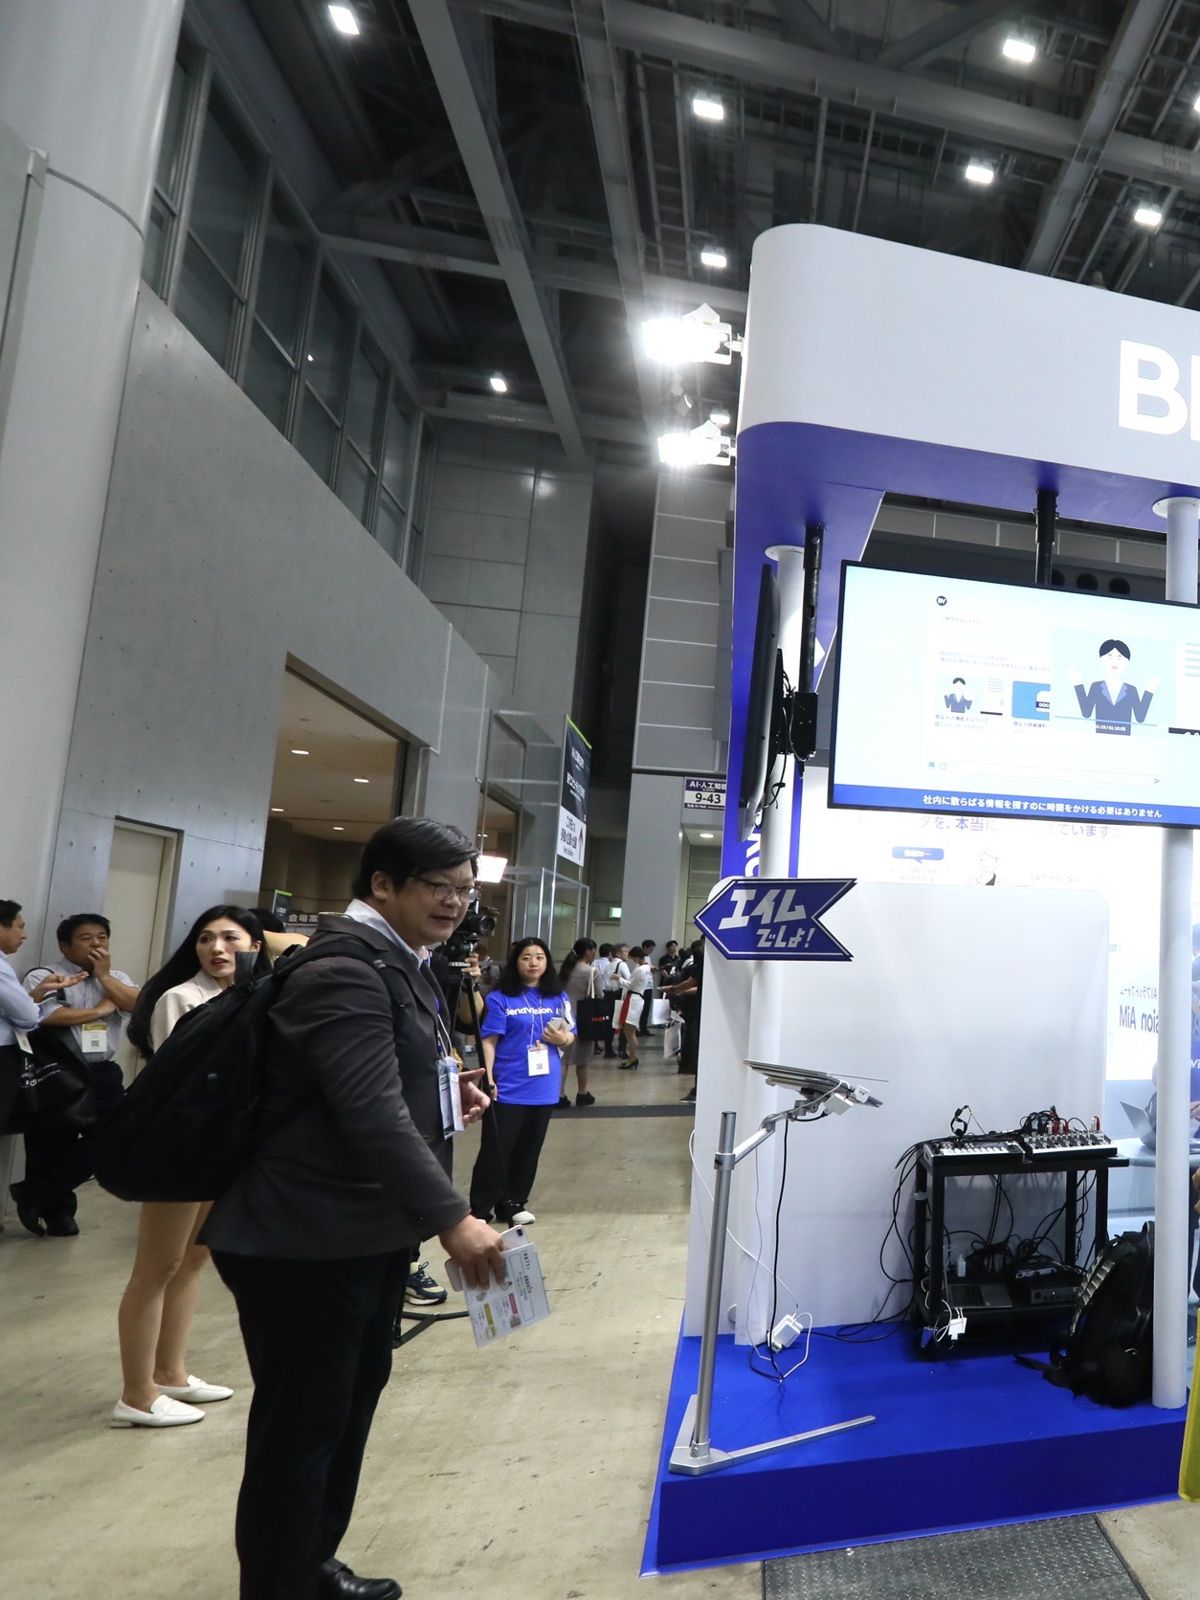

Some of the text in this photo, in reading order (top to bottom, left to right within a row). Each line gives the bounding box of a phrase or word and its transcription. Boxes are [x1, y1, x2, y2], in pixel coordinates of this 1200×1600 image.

[695, 792, 721, 804] 9-43
[922, 794, 1162, 818] 社内に散らばる情報を探すのに時間をかける必要はありません
[718, 889, 807, 930] エイム
